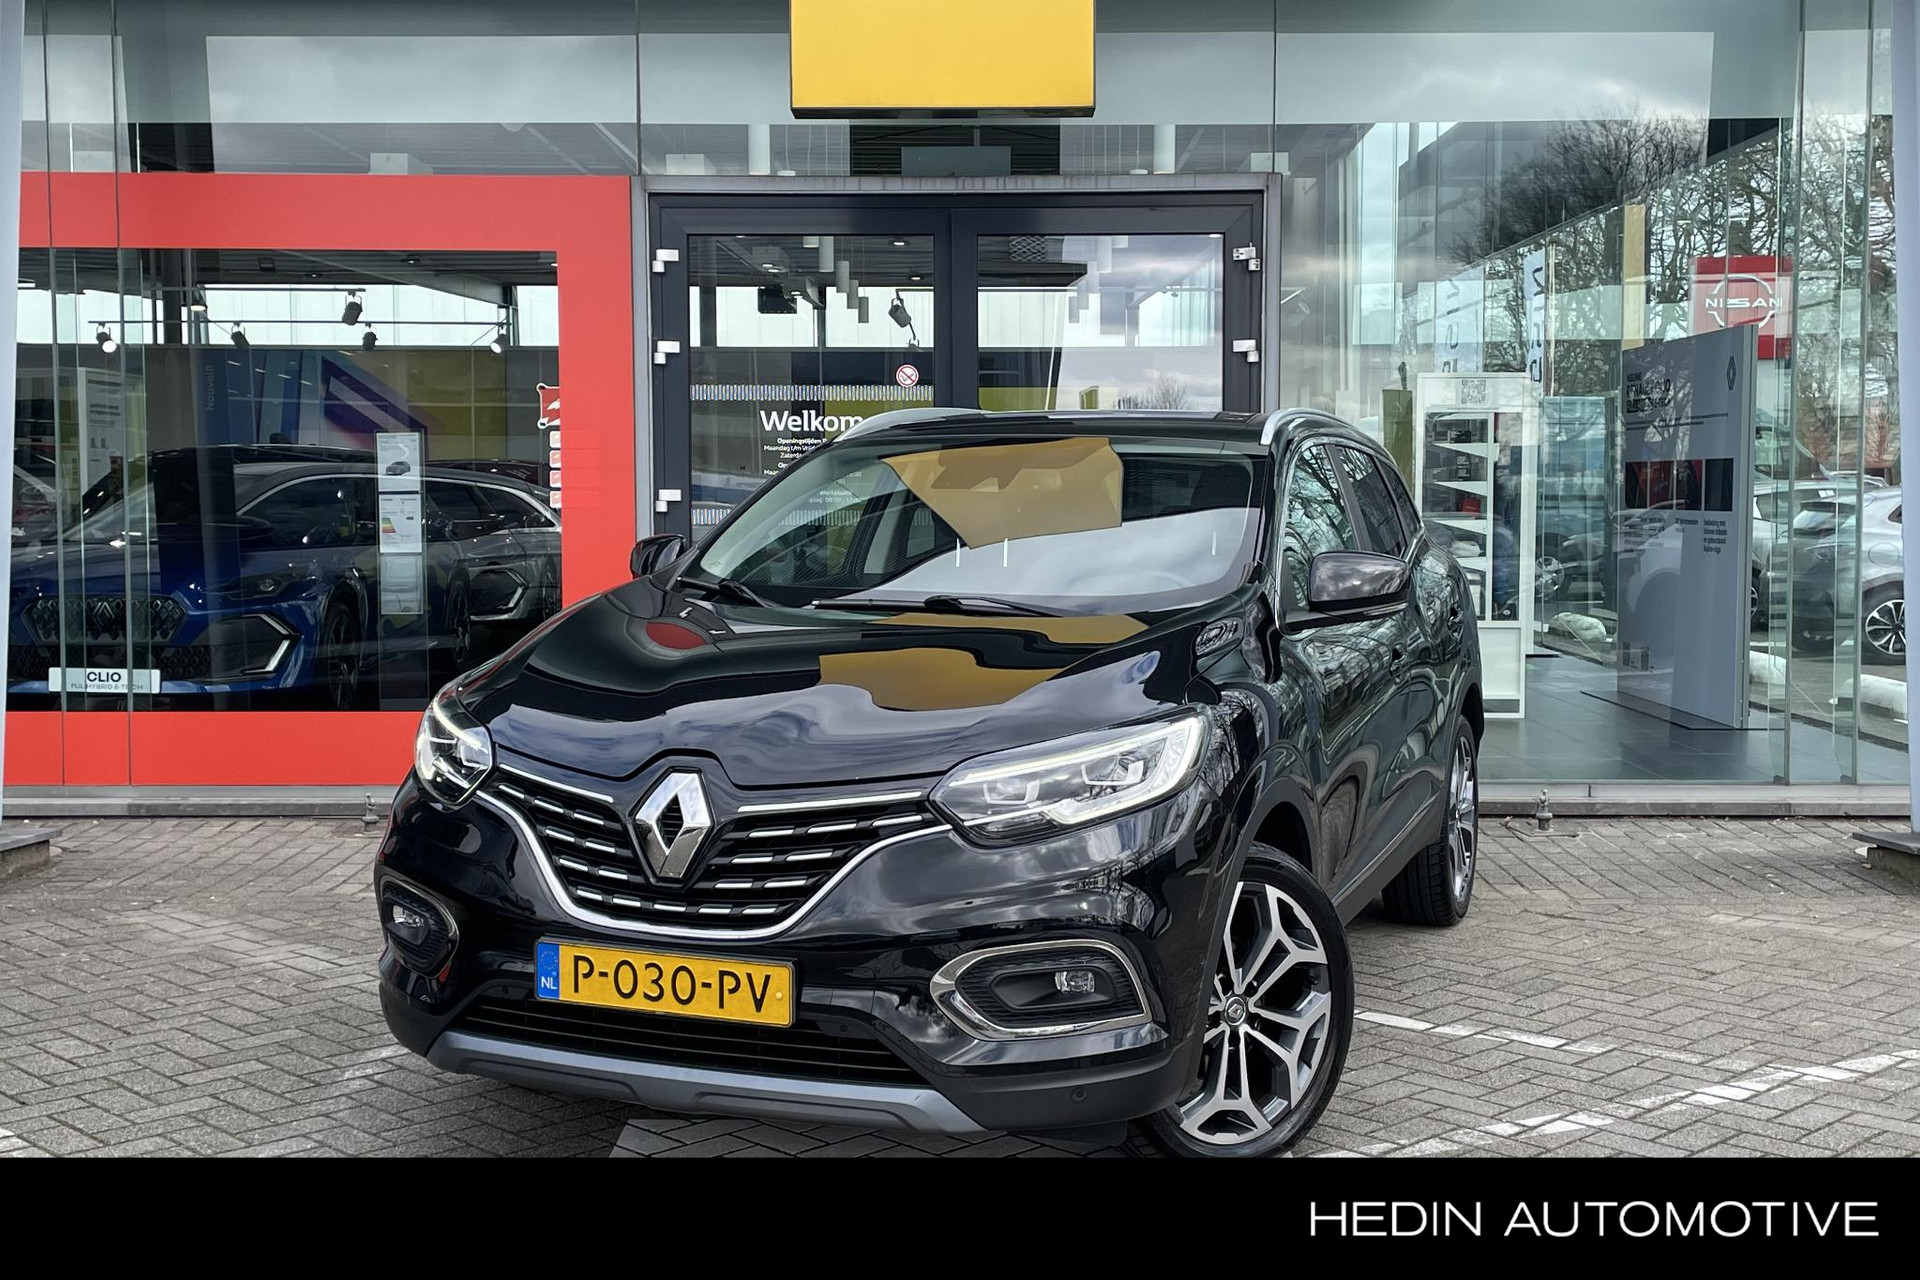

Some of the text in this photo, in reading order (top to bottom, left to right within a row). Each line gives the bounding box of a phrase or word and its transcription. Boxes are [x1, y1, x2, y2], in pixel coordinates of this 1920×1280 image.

[1705, 298, 1782, 308] NISSAN
[760, 410, 863, 432] Welkom
[87, 672, 121, 682] CLIO
[541, 976, 558, 990] NL
[573, 954, 771, 1013] P-030-PV
